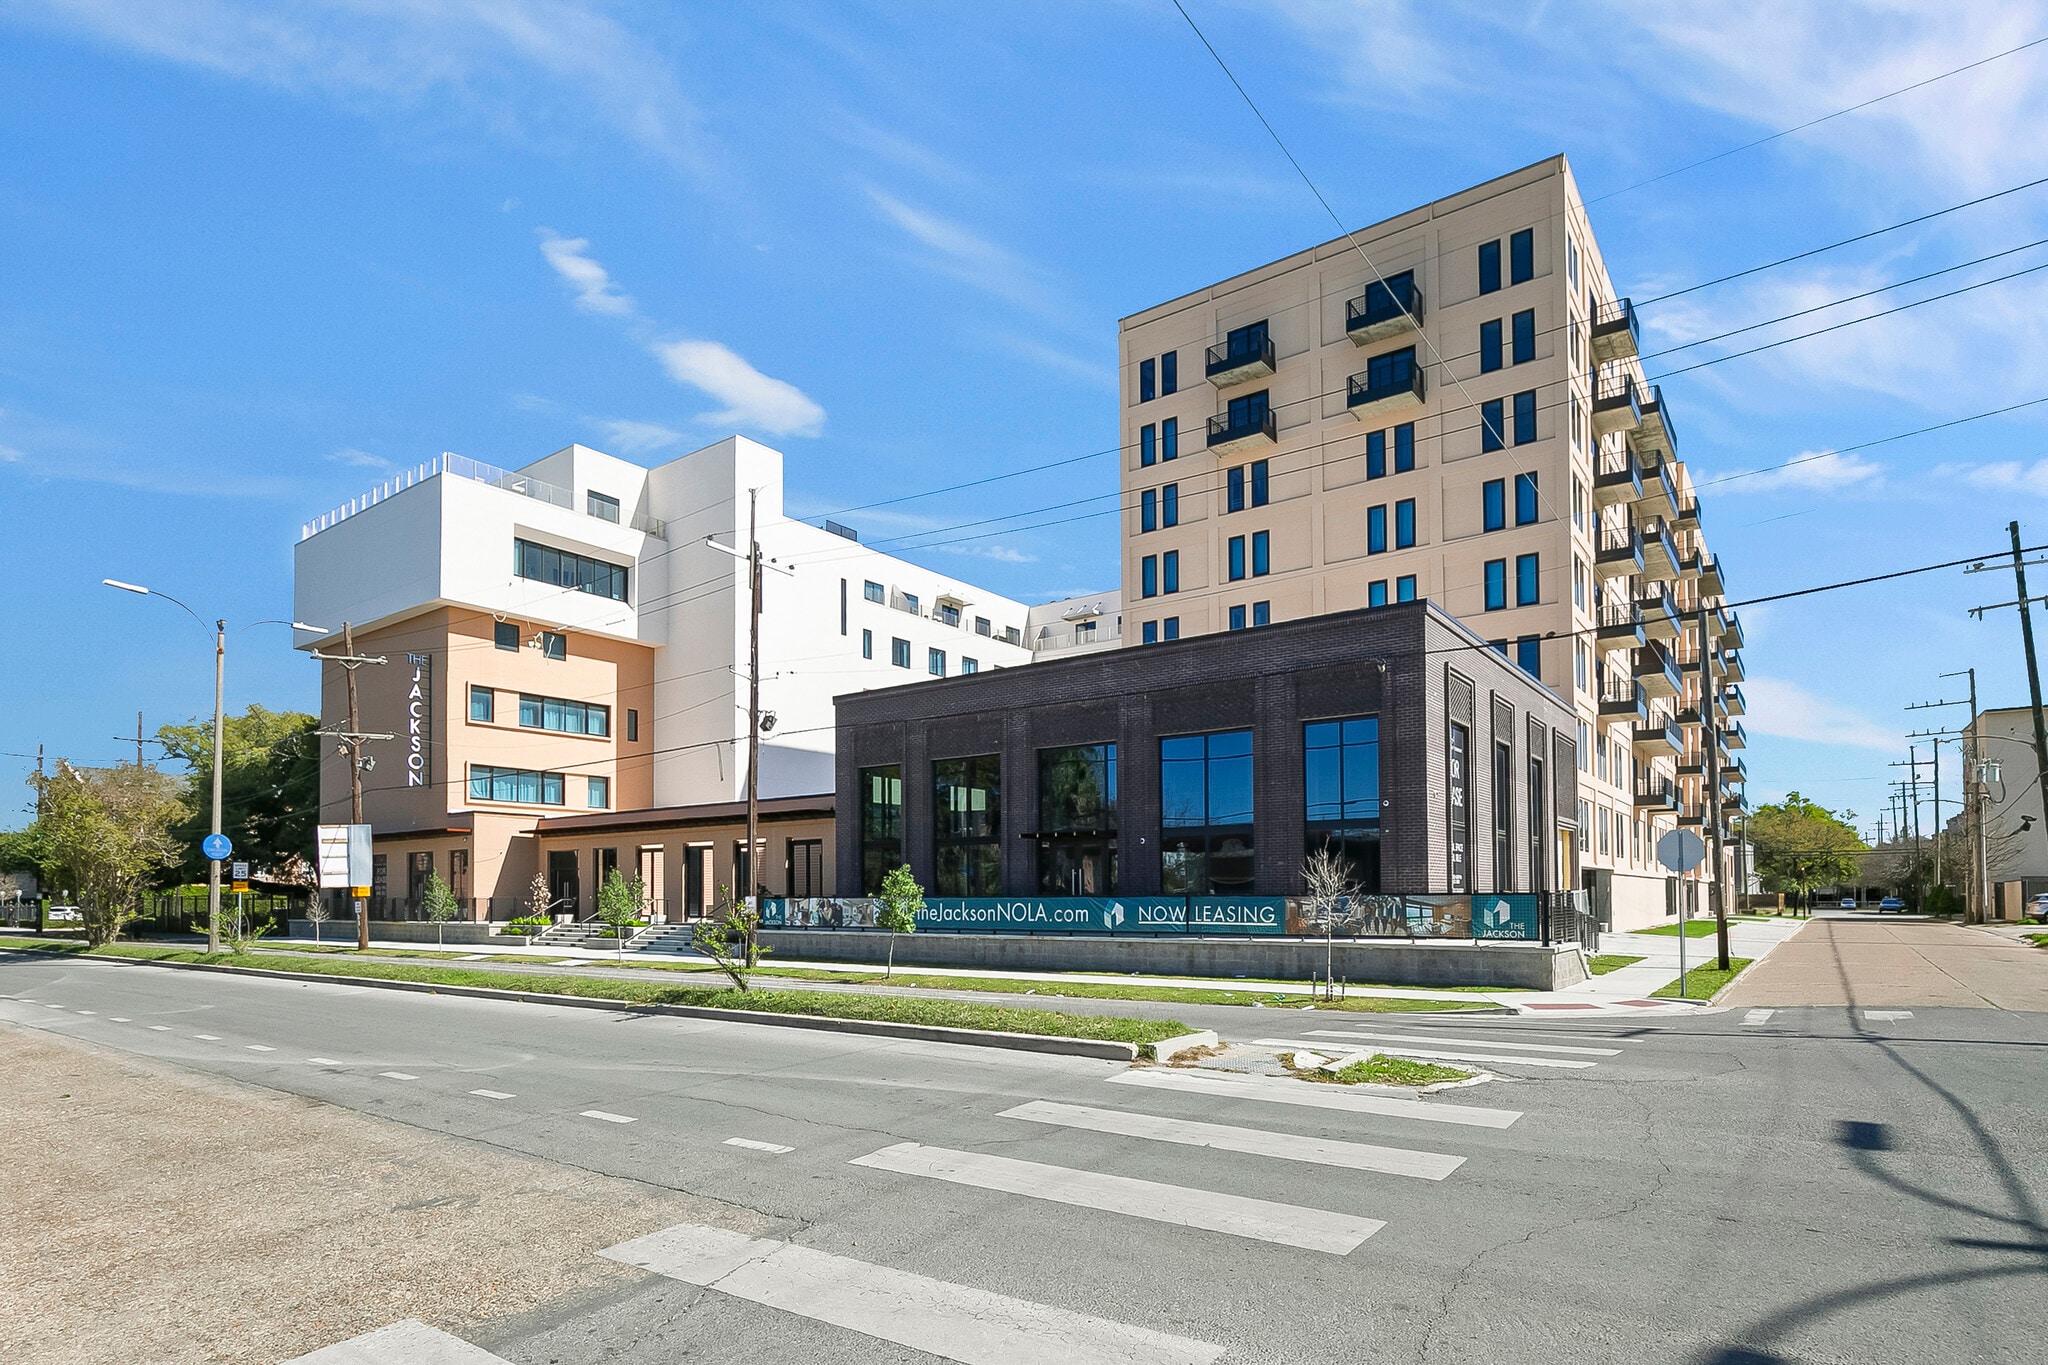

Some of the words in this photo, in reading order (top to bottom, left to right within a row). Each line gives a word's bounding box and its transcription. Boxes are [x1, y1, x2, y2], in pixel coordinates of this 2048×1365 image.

[407, 653, 427, 666] THE
[407, 667, 424, 787] JACKSON
[1138, 905, 1187, 922] NOW
[1195, 905, 1275, 923] LEASING
[1510, 922, 1525, 930] THE
[1482, 930, 1525, 939] JACKSON
